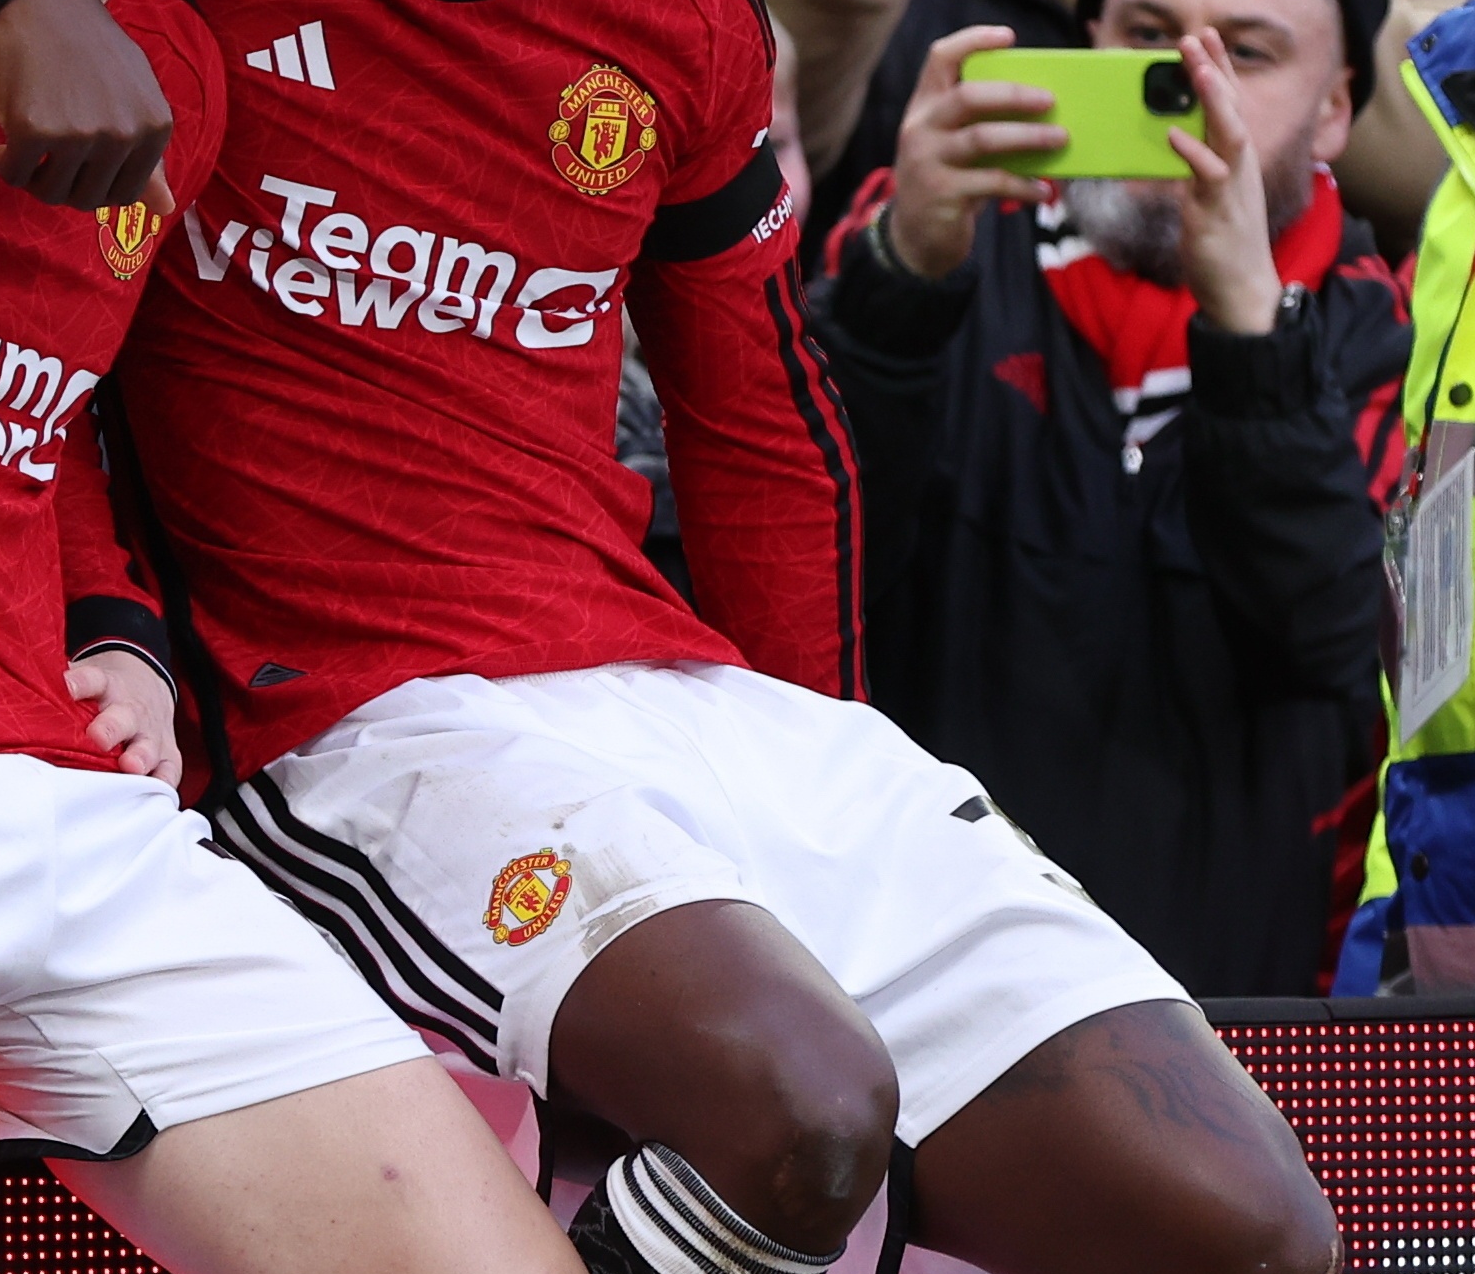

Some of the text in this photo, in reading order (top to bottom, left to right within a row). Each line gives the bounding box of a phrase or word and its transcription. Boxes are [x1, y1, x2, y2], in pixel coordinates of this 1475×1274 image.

[567, 74, 649, 118] MANCHESTER
[566, 162, 627, 186] UNITED
[108, 246, 143, 271] UNITED
[260, 173, 517, 306] Team
[183, 200, 502, 339] Viewer
[491, 857, 549, 920] MANCHESTER
[523, 891, 564, 938] UNITED
